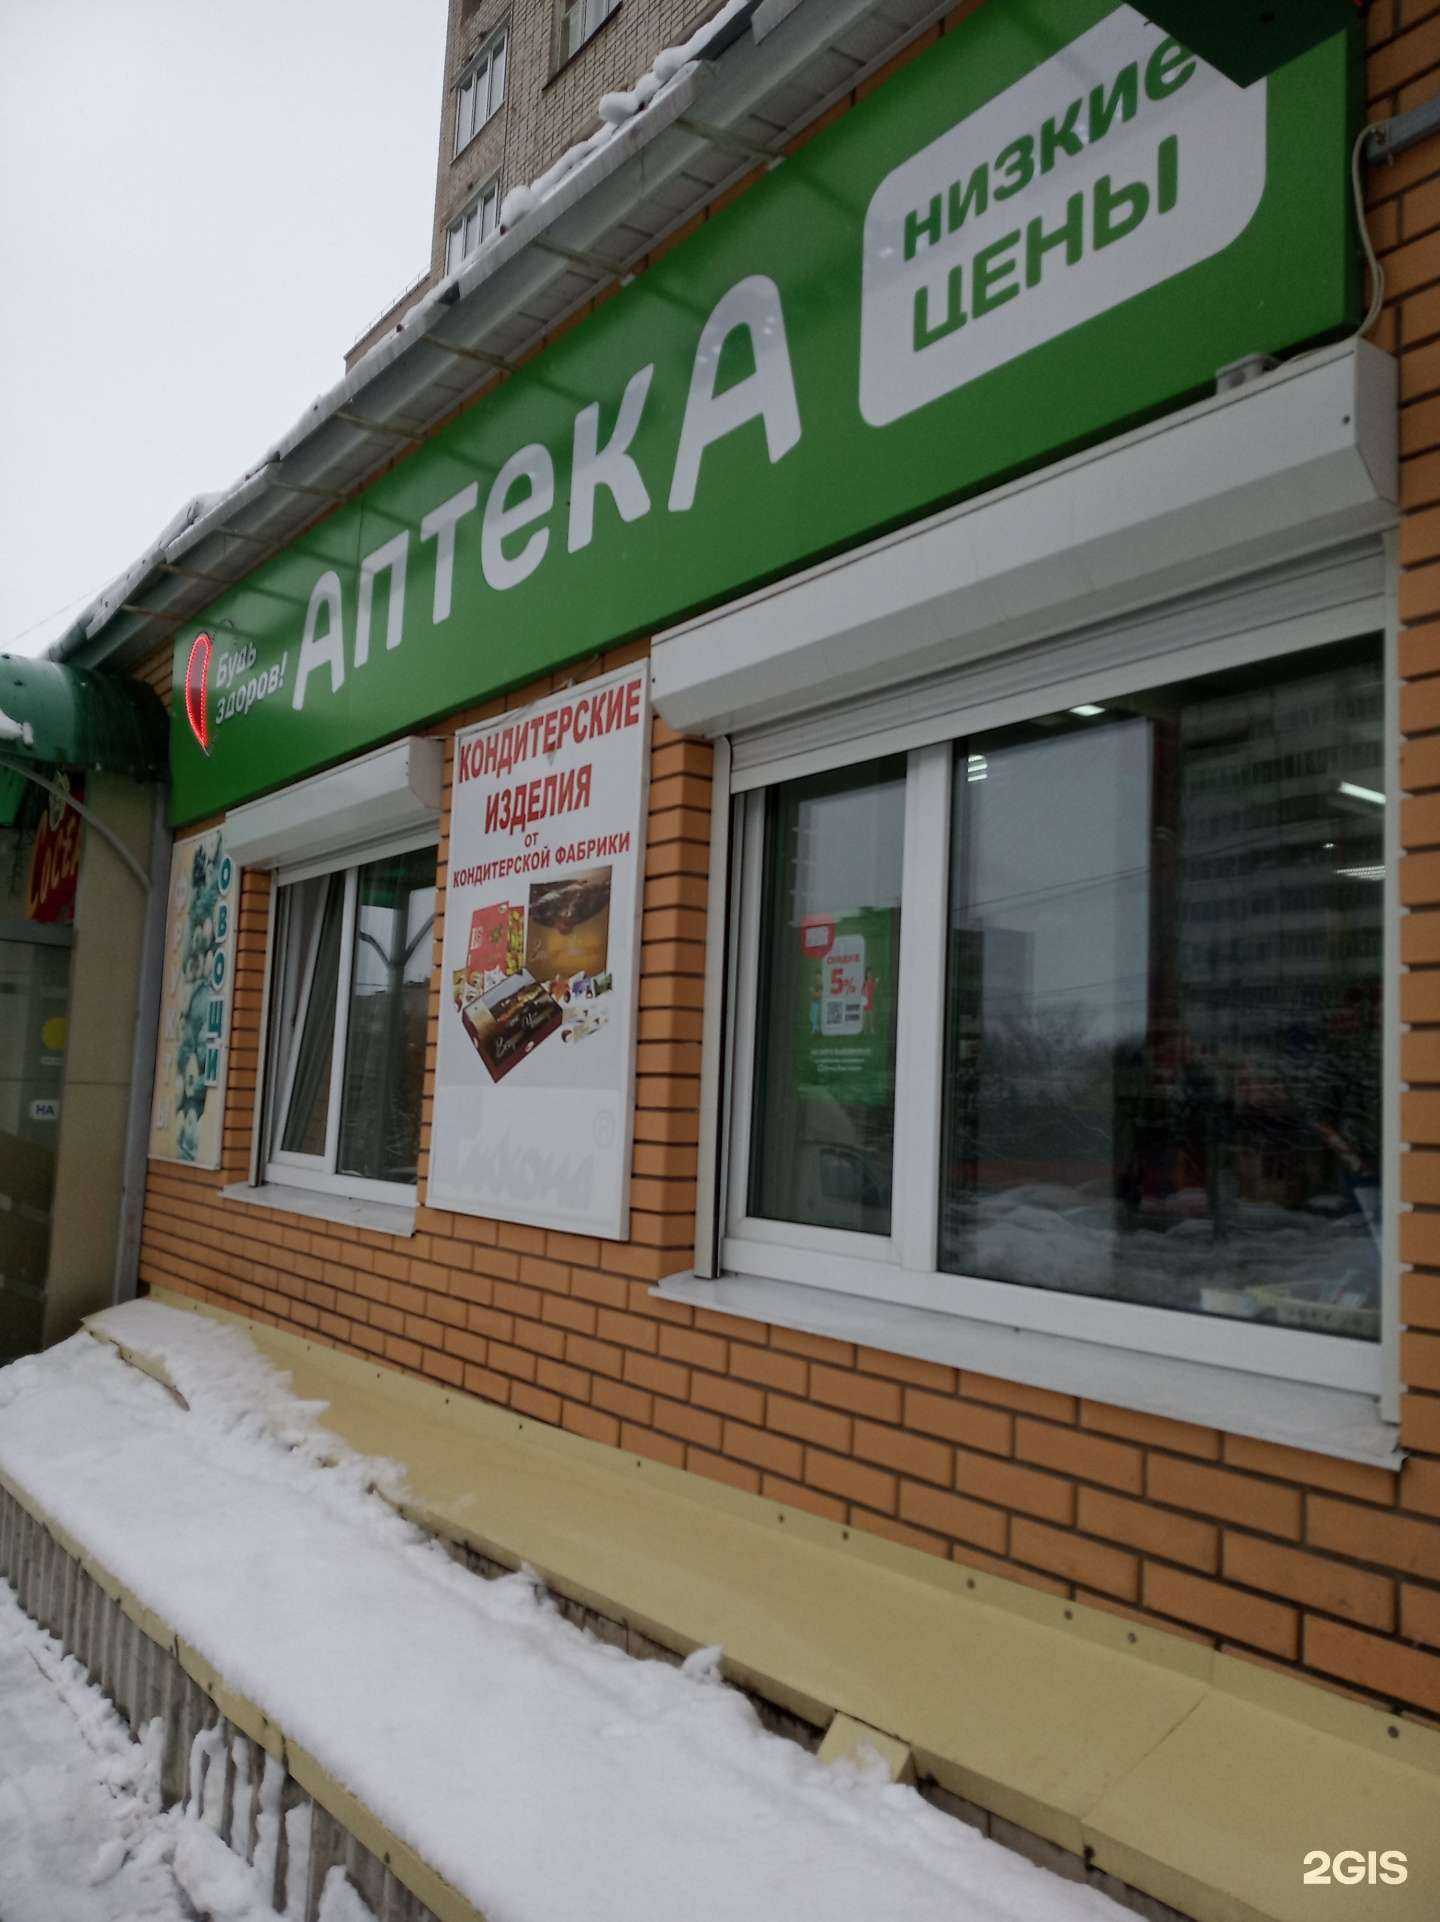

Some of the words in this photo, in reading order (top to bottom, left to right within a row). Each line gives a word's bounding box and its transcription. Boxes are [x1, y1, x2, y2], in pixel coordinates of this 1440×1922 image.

[913, 134, 1178, 352] ЦЕНЫ
[215, 651, 288, 724] здоров!
[216, 640, 257, 688] Будь
[458, 679, 642, 784] КОНДИТЕРСКИЕ
[484, 763, 593, 835] ИЗДЕЛИЯ
[453, 845, 550, 888] КОНДИТЕРСКОЙ
[555, 832, 630, 865] ФАБРИКИ
[205, 856, 232, 1086] ОВОЩИ
